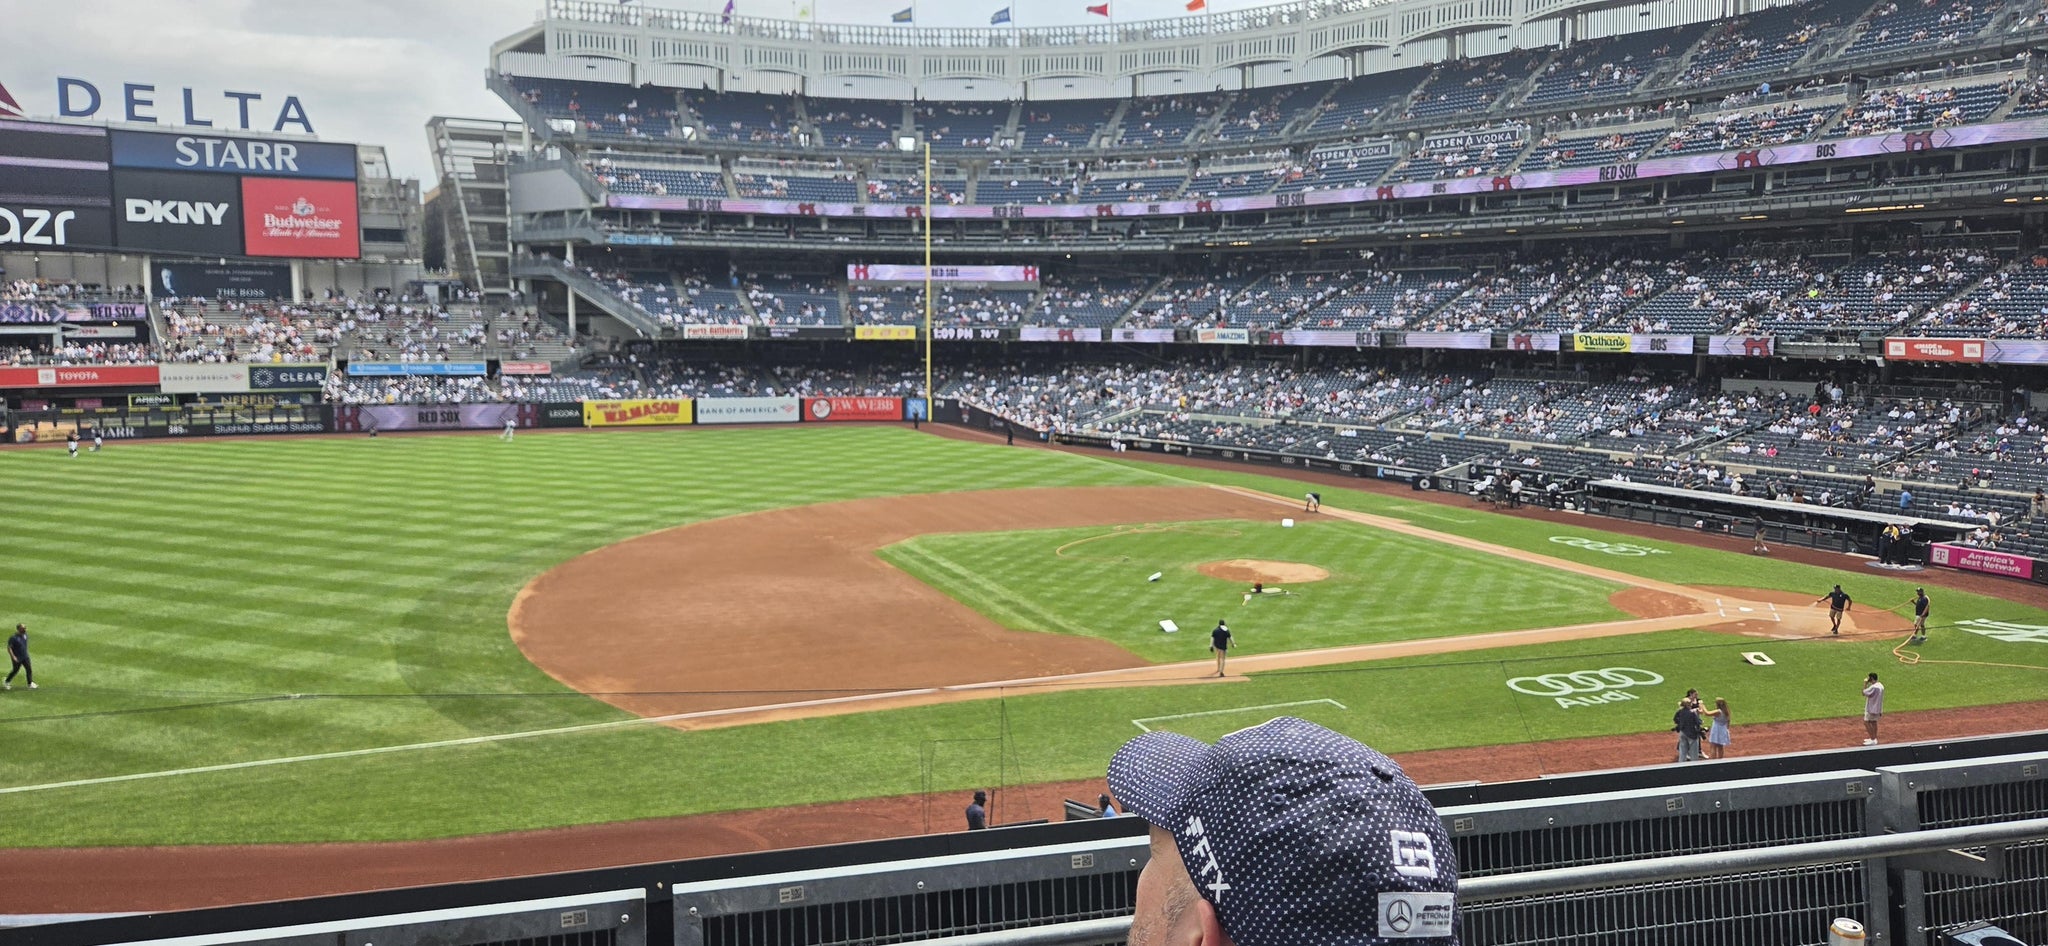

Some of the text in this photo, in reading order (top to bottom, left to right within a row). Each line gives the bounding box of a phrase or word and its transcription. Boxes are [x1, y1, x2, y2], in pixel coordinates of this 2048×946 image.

[57, 76, 314, 133] DELTA
[1429, 132, 1512, 149] ASPEN VODKA
[175, 136, 299, 172] STARR
[1316, 146, 1387, 161] ASPEN VODKA
[1816, 144, 1837, 158] BOS
[1599, 163, 1638, 181] RED SOX
[125, 198, 229, 225] DKNY
[264, 213, 342, 229] Budweiser
[217, 287, 265, 297] THE BOSS
[91, 304, 137, 319] RED SOX
[933, 328, 955, 339] 1:09
[957, 328, 973, 339] PM
[1579, 334, 1627, 348] Nathan's
[59, 371, 98, 381] TOYOTA
[279, 372, 323, 383] CLEAR
[700, 407, 724, 415] BANK
[739, 406, 778, 414] AMERICA
[857, 399, 894, 411] WEBB
[418, 411, 460, 423] RED SOX
[550, 409, 580, 418] LEGORA
[1960, 557, 2021, 573] Best Network
[1968, 552, 2015, 566] America's
[1555, 689, 1639, 709] Audi
[1193, 836, 1231, 903] FTX
